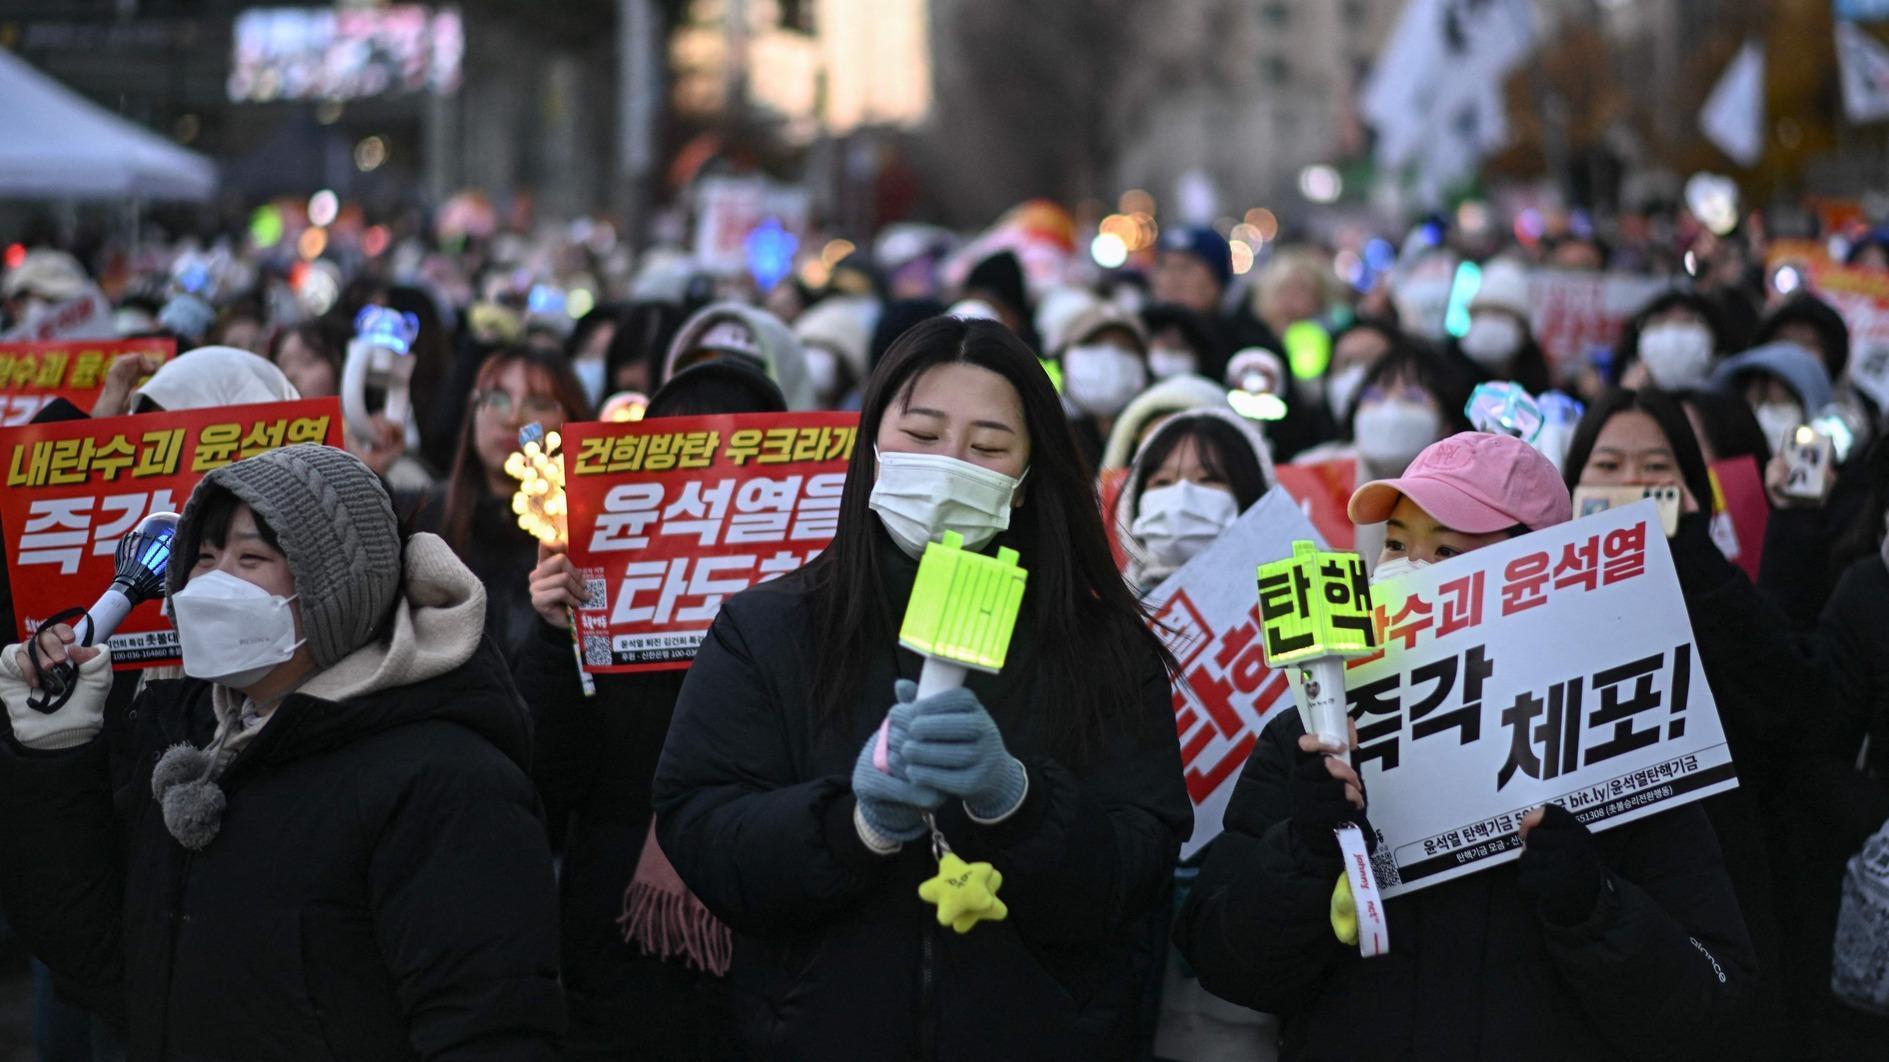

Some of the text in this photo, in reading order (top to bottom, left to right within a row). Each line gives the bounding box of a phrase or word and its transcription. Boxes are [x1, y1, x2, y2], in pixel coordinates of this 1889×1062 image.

[6, 427, 186, 488] 내란수괴
[574, 431, 719, 475] 건희방탄
[588, 473, 848, 553] 윤석열을
[1501, 521, 1646, 617] 윤석열
[1257, 560, 1376, 656] 탄핵
[620, 638, 645, 650] 윤석열
[646, 637, 661, 648] 퇴진
[663, 636, 688, 648] 김건희
[1346, 642, 1691, 792] 즉각 체포!
[1569, 754, 1699, 810] bit.ly/윤석열탄핵기금
[1423, 815, 1513, 856] 윤석열 탄핵기금
[1456, 844, 1488, 864] 탄핵기금
[1488, 840, 1506, 854] 모금
[1352, 852, 1370, 890] johnny
